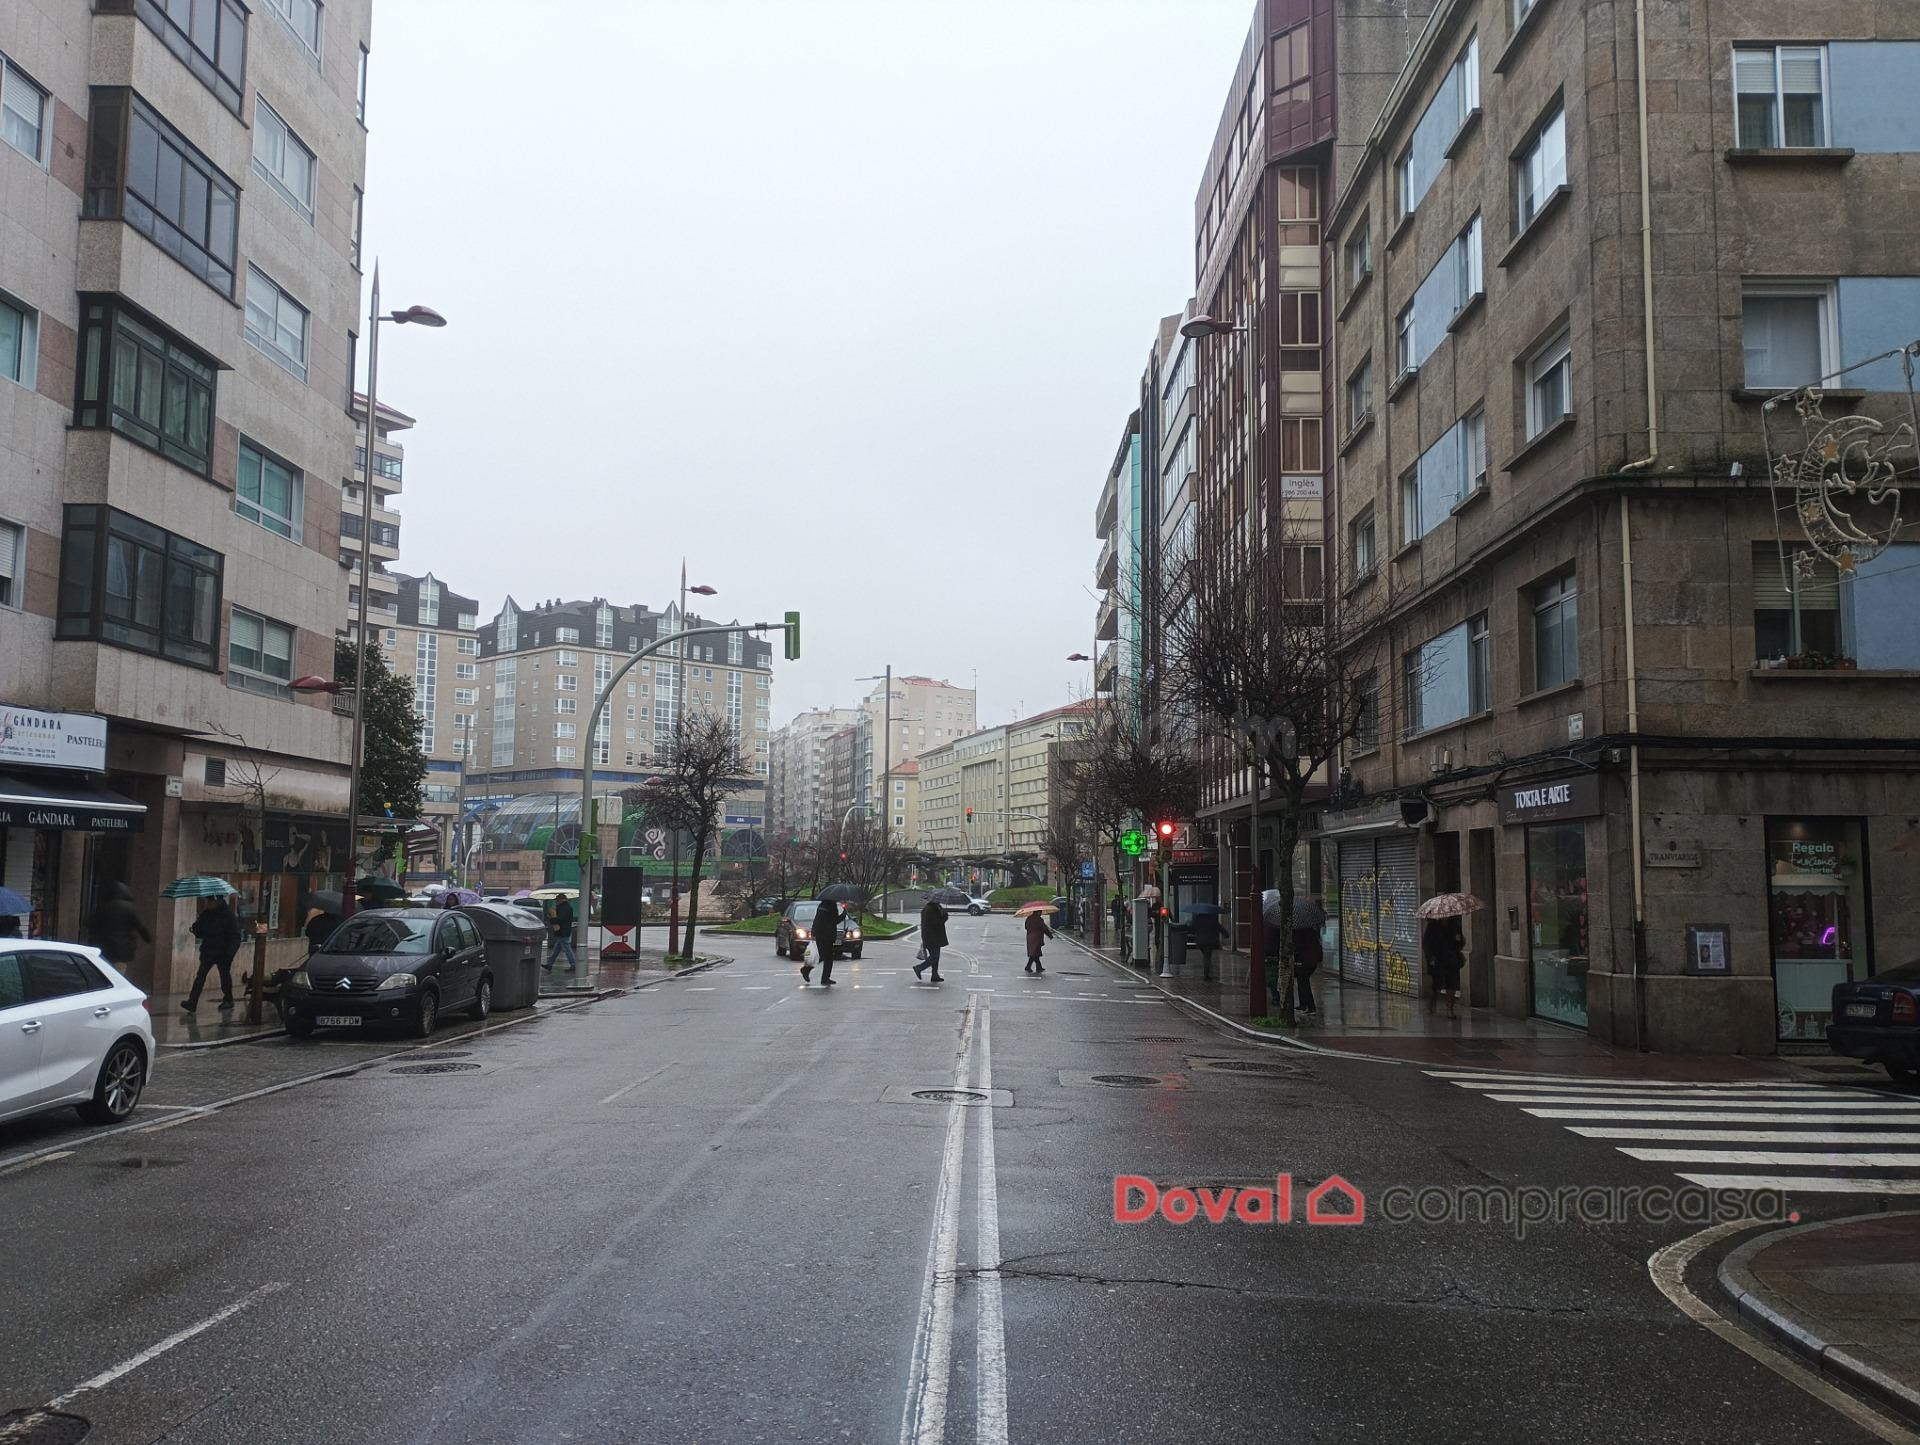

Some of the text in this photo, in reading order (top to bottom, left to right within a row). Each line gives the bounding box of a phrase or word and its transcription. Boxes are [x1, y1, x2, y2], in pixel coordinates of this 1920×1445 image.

[13, 714, 62, 730] GÁNDARA
[1514, 783, 1572, 809] TORTA E ARTE
[28, 809, 76, 826] GÁNDARA
[1792, 842, 1835, 855] Regala
